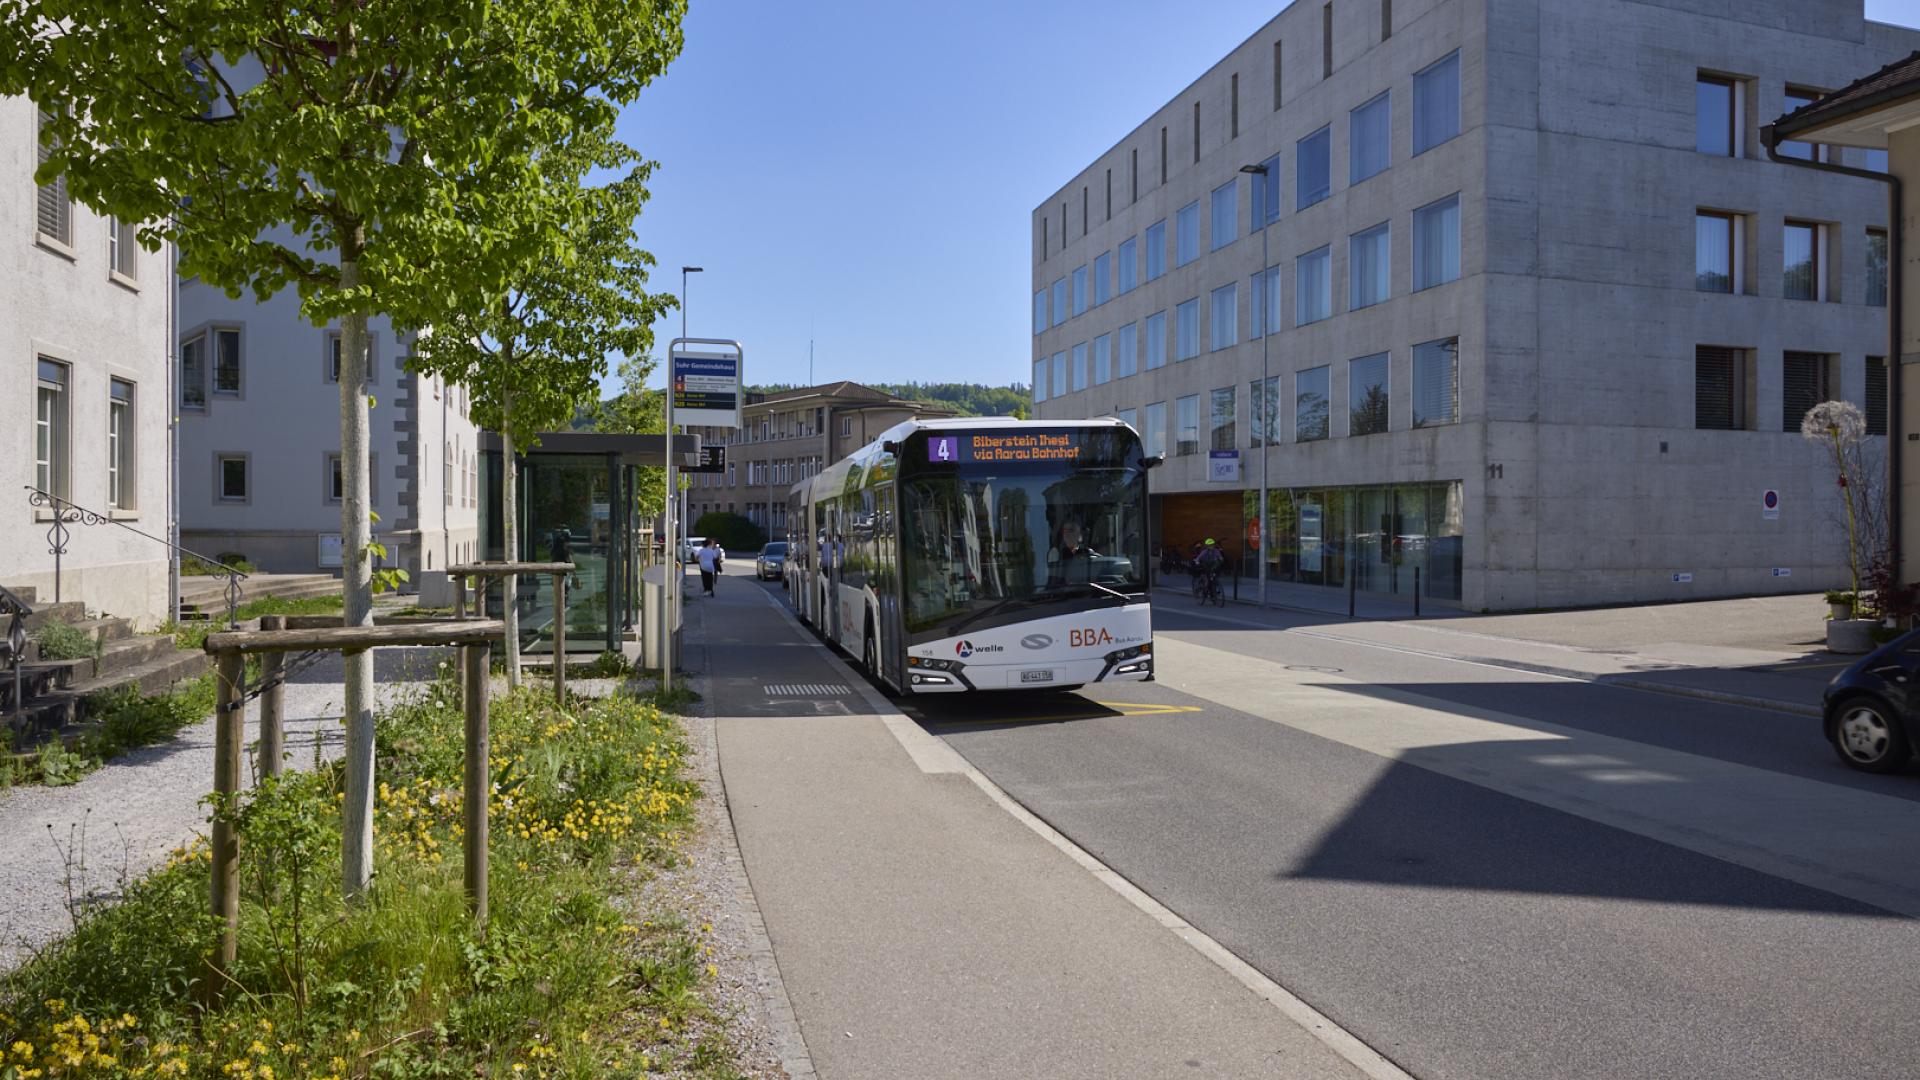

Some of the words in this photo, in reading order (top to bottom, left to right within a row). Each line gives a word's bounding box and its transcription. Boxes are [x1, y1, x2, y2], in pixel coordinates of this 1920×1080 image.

[675, 361, 689, 369] Suhr
[973, 435, 1037, 448] Biberstein
[937, 439, 950, 461] 4
[974, 448, 993, 460] via
[995, 448, 1030, 460] Aarau
[1032, 446, 1080, 459] Bahnhof
[1489, 463, 1503, 479] 11
[1069, 627, 1113, 647] BBA
[975, 644, 1004, 653] welle
